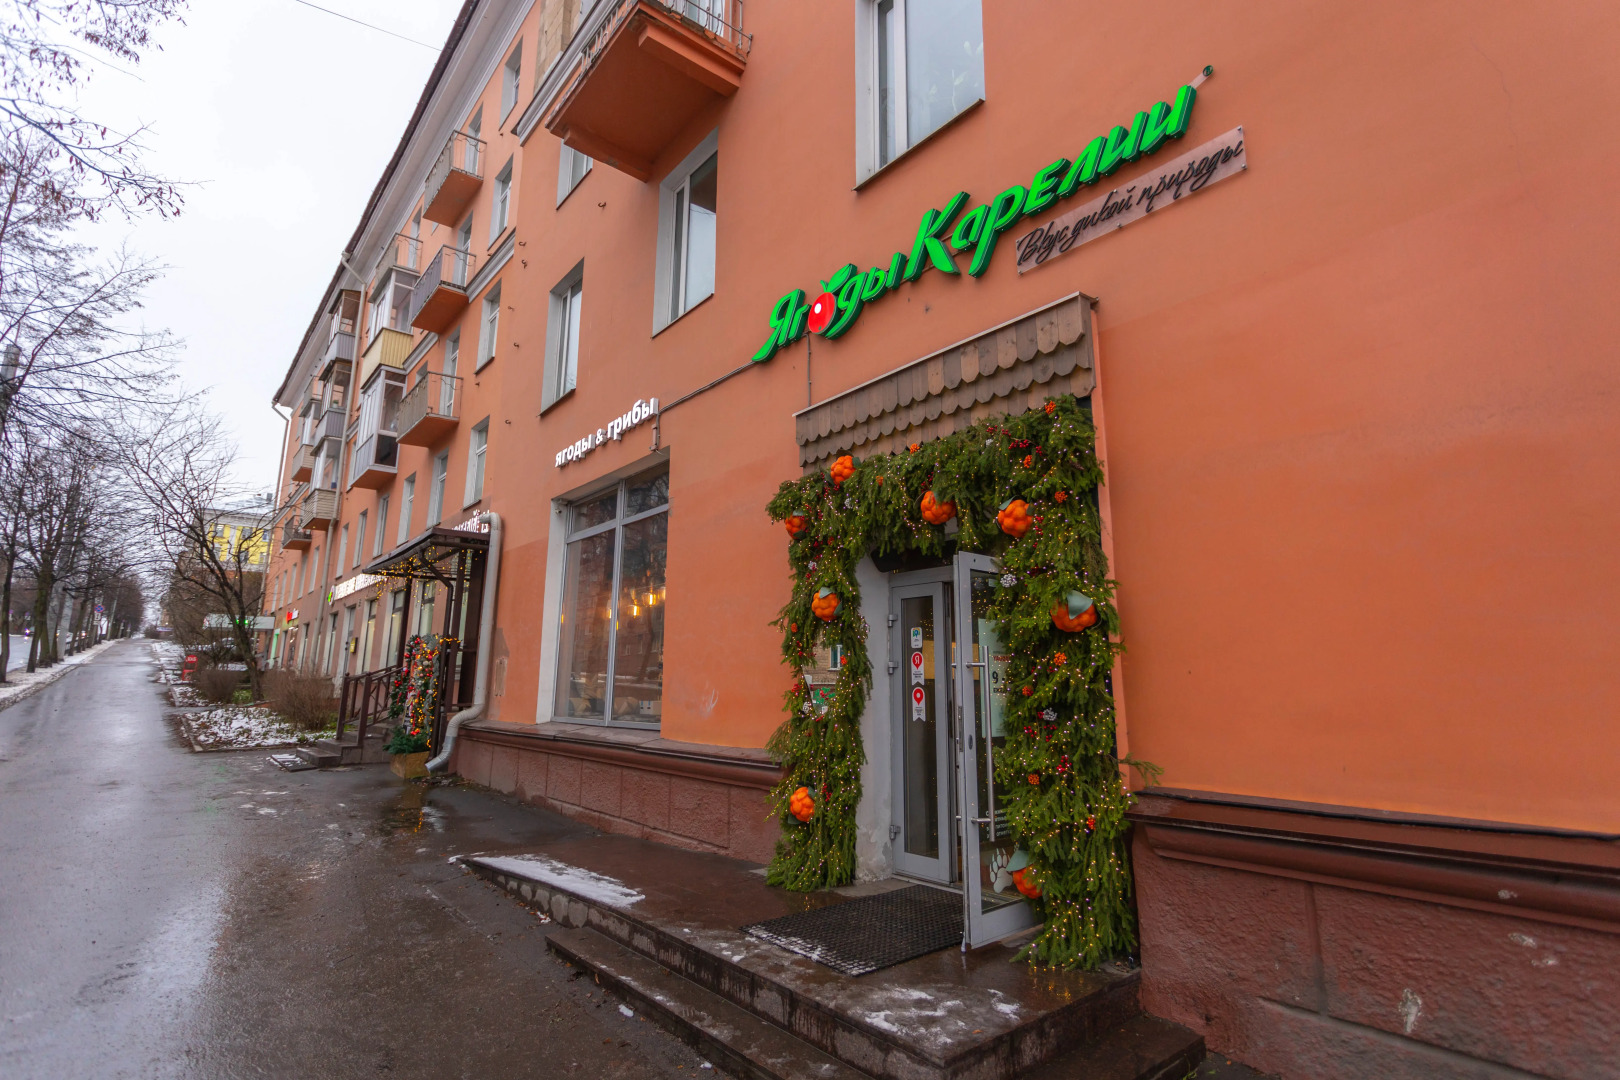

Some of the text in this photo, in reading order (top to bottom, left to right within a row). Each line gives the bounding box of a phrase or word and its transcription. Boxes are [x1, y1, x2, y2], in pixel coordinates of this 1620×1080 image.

[1017, 140, 1244, 266] Вкус дикой природы
[752, 263, 907, 362] Ягоды
[555, 397, 659, 468] ягоды & грибы
